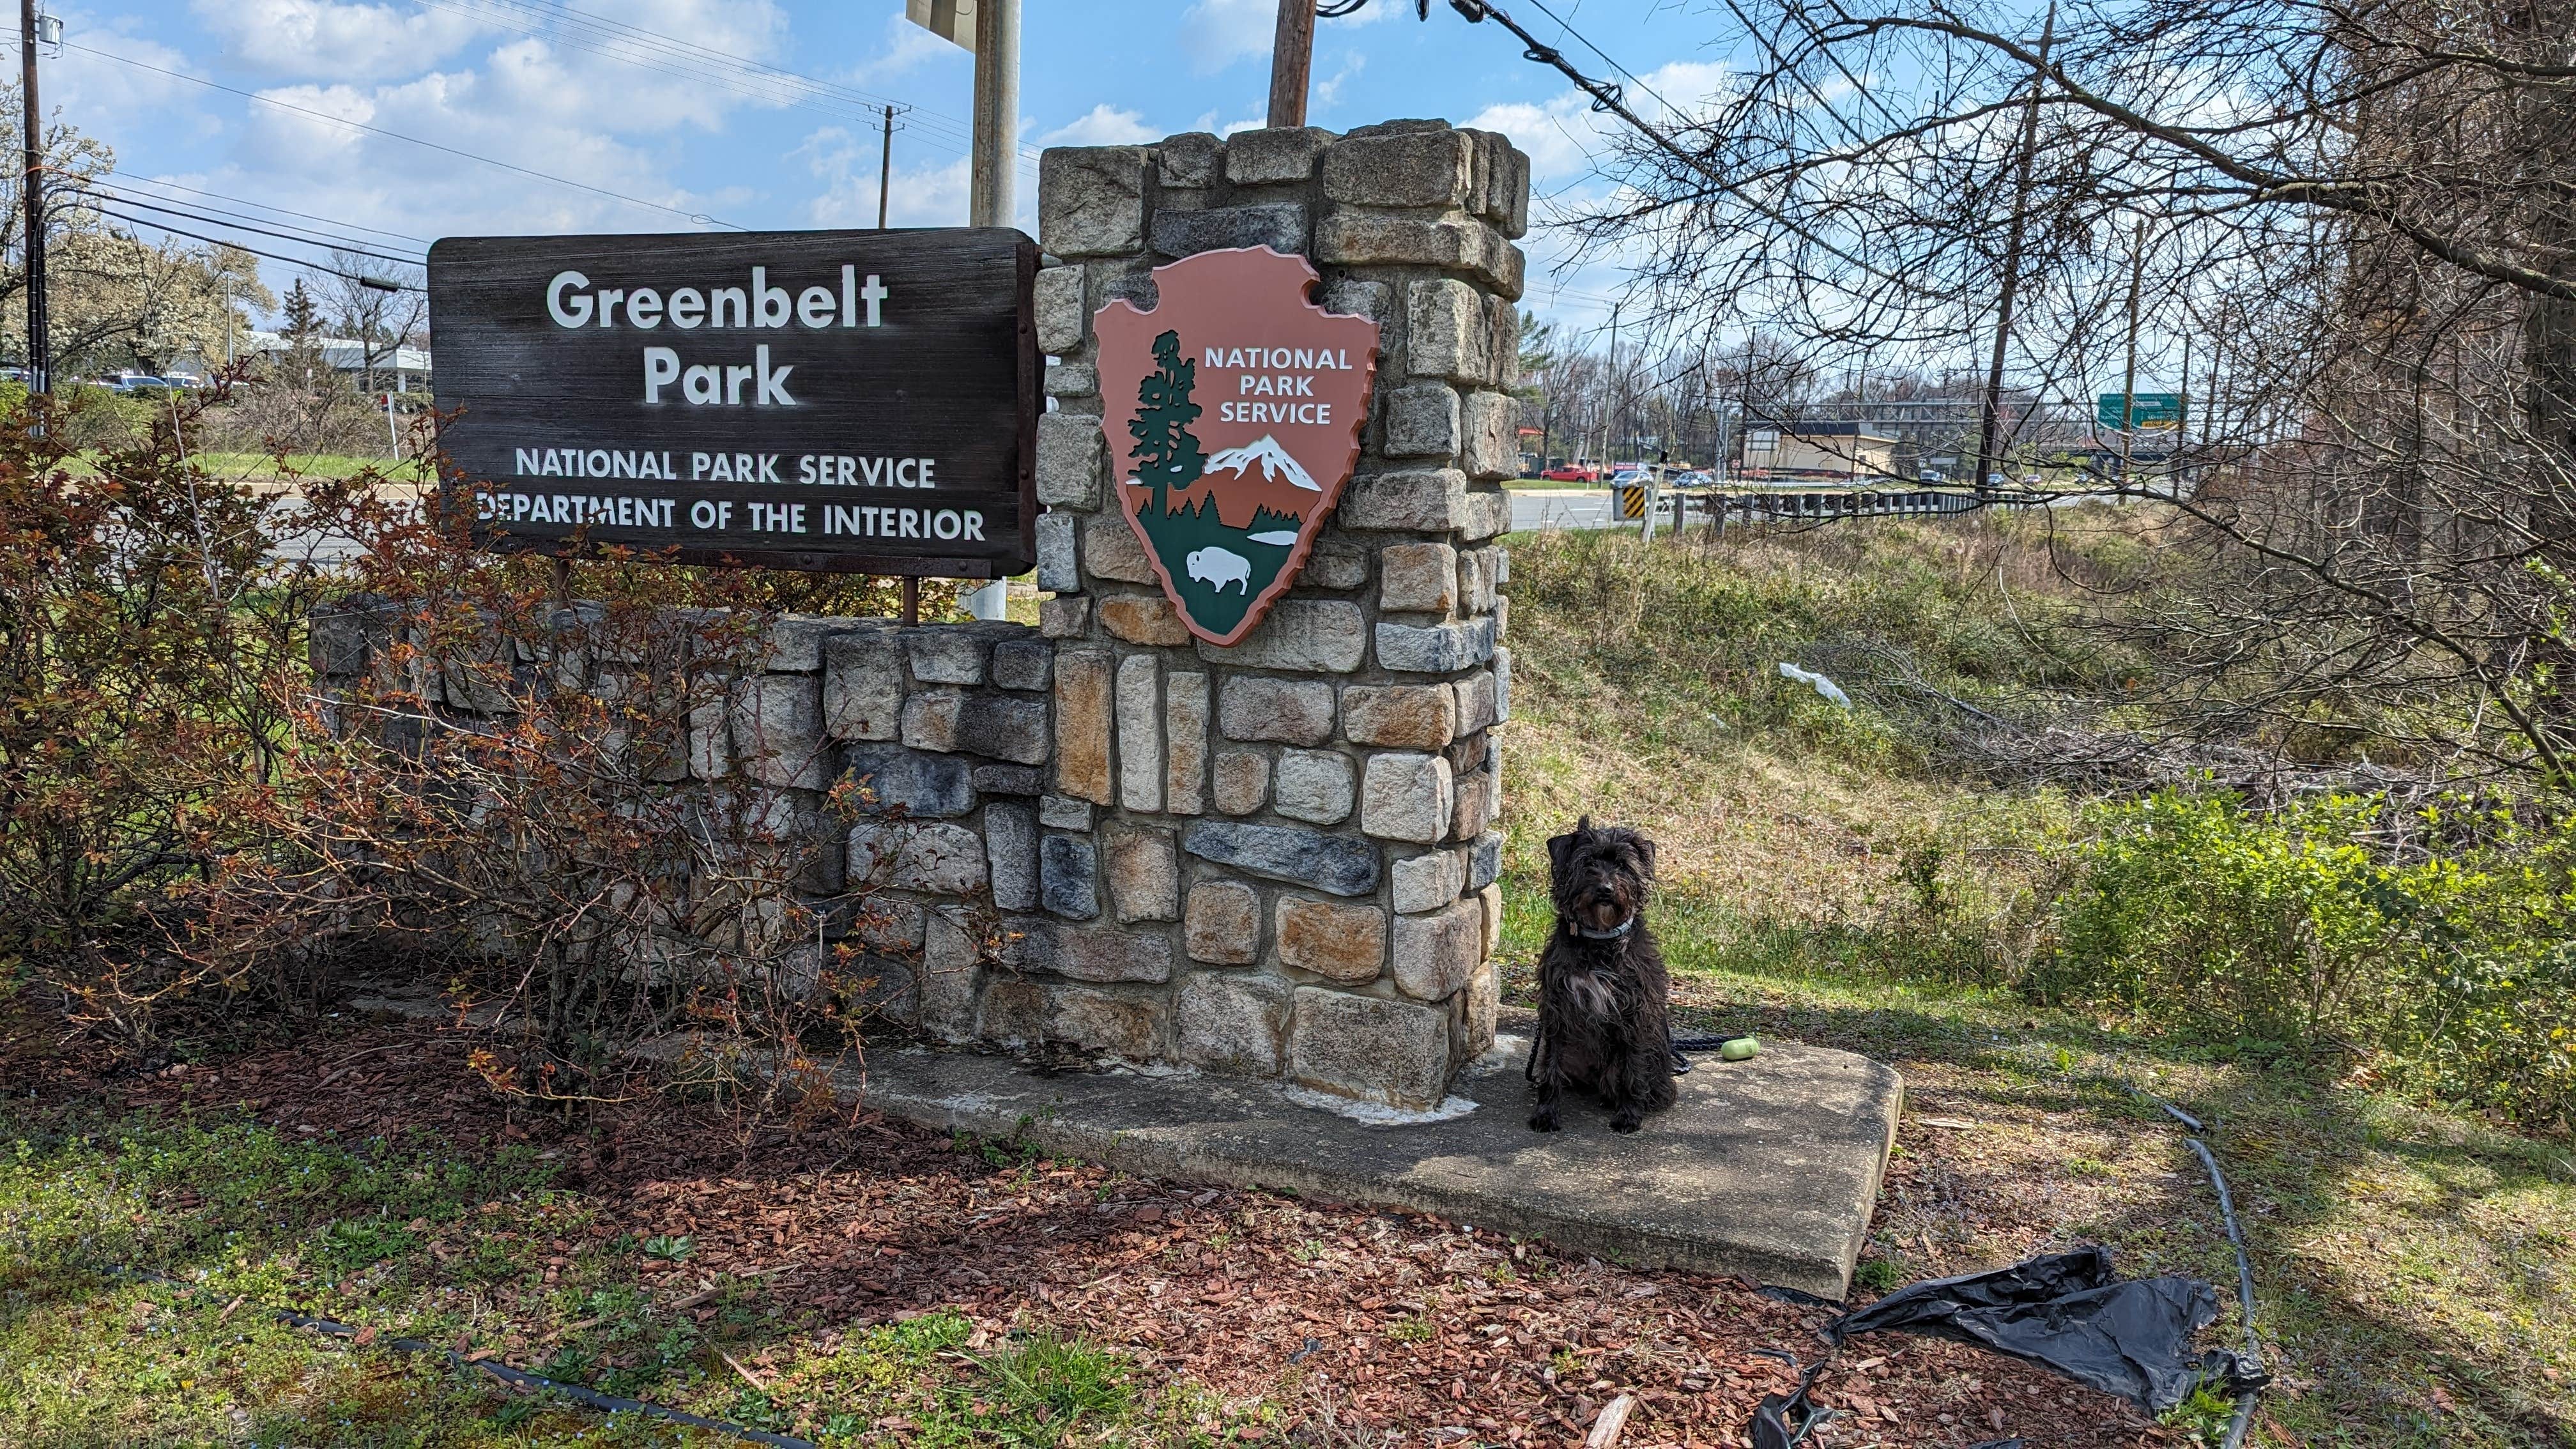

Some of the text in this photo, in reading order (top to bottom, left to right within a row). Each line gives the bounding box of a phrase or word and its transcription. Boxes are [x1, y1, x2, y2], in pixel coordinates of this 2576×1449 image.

[546, 264, 888, 328] Greenbelt
[643, 344, 797, 406] Park
[1205, 347, 1353, 370] NATIONAL
[1240, 375, 1315, 397] PARK
[1220, 401, 1332, 424] SERVICE
[516, 447, 935, 489] NATIONAL PARK SERVICE
[476, 492, 985, 541] DEPARTMENT OF THE INTERIOR
